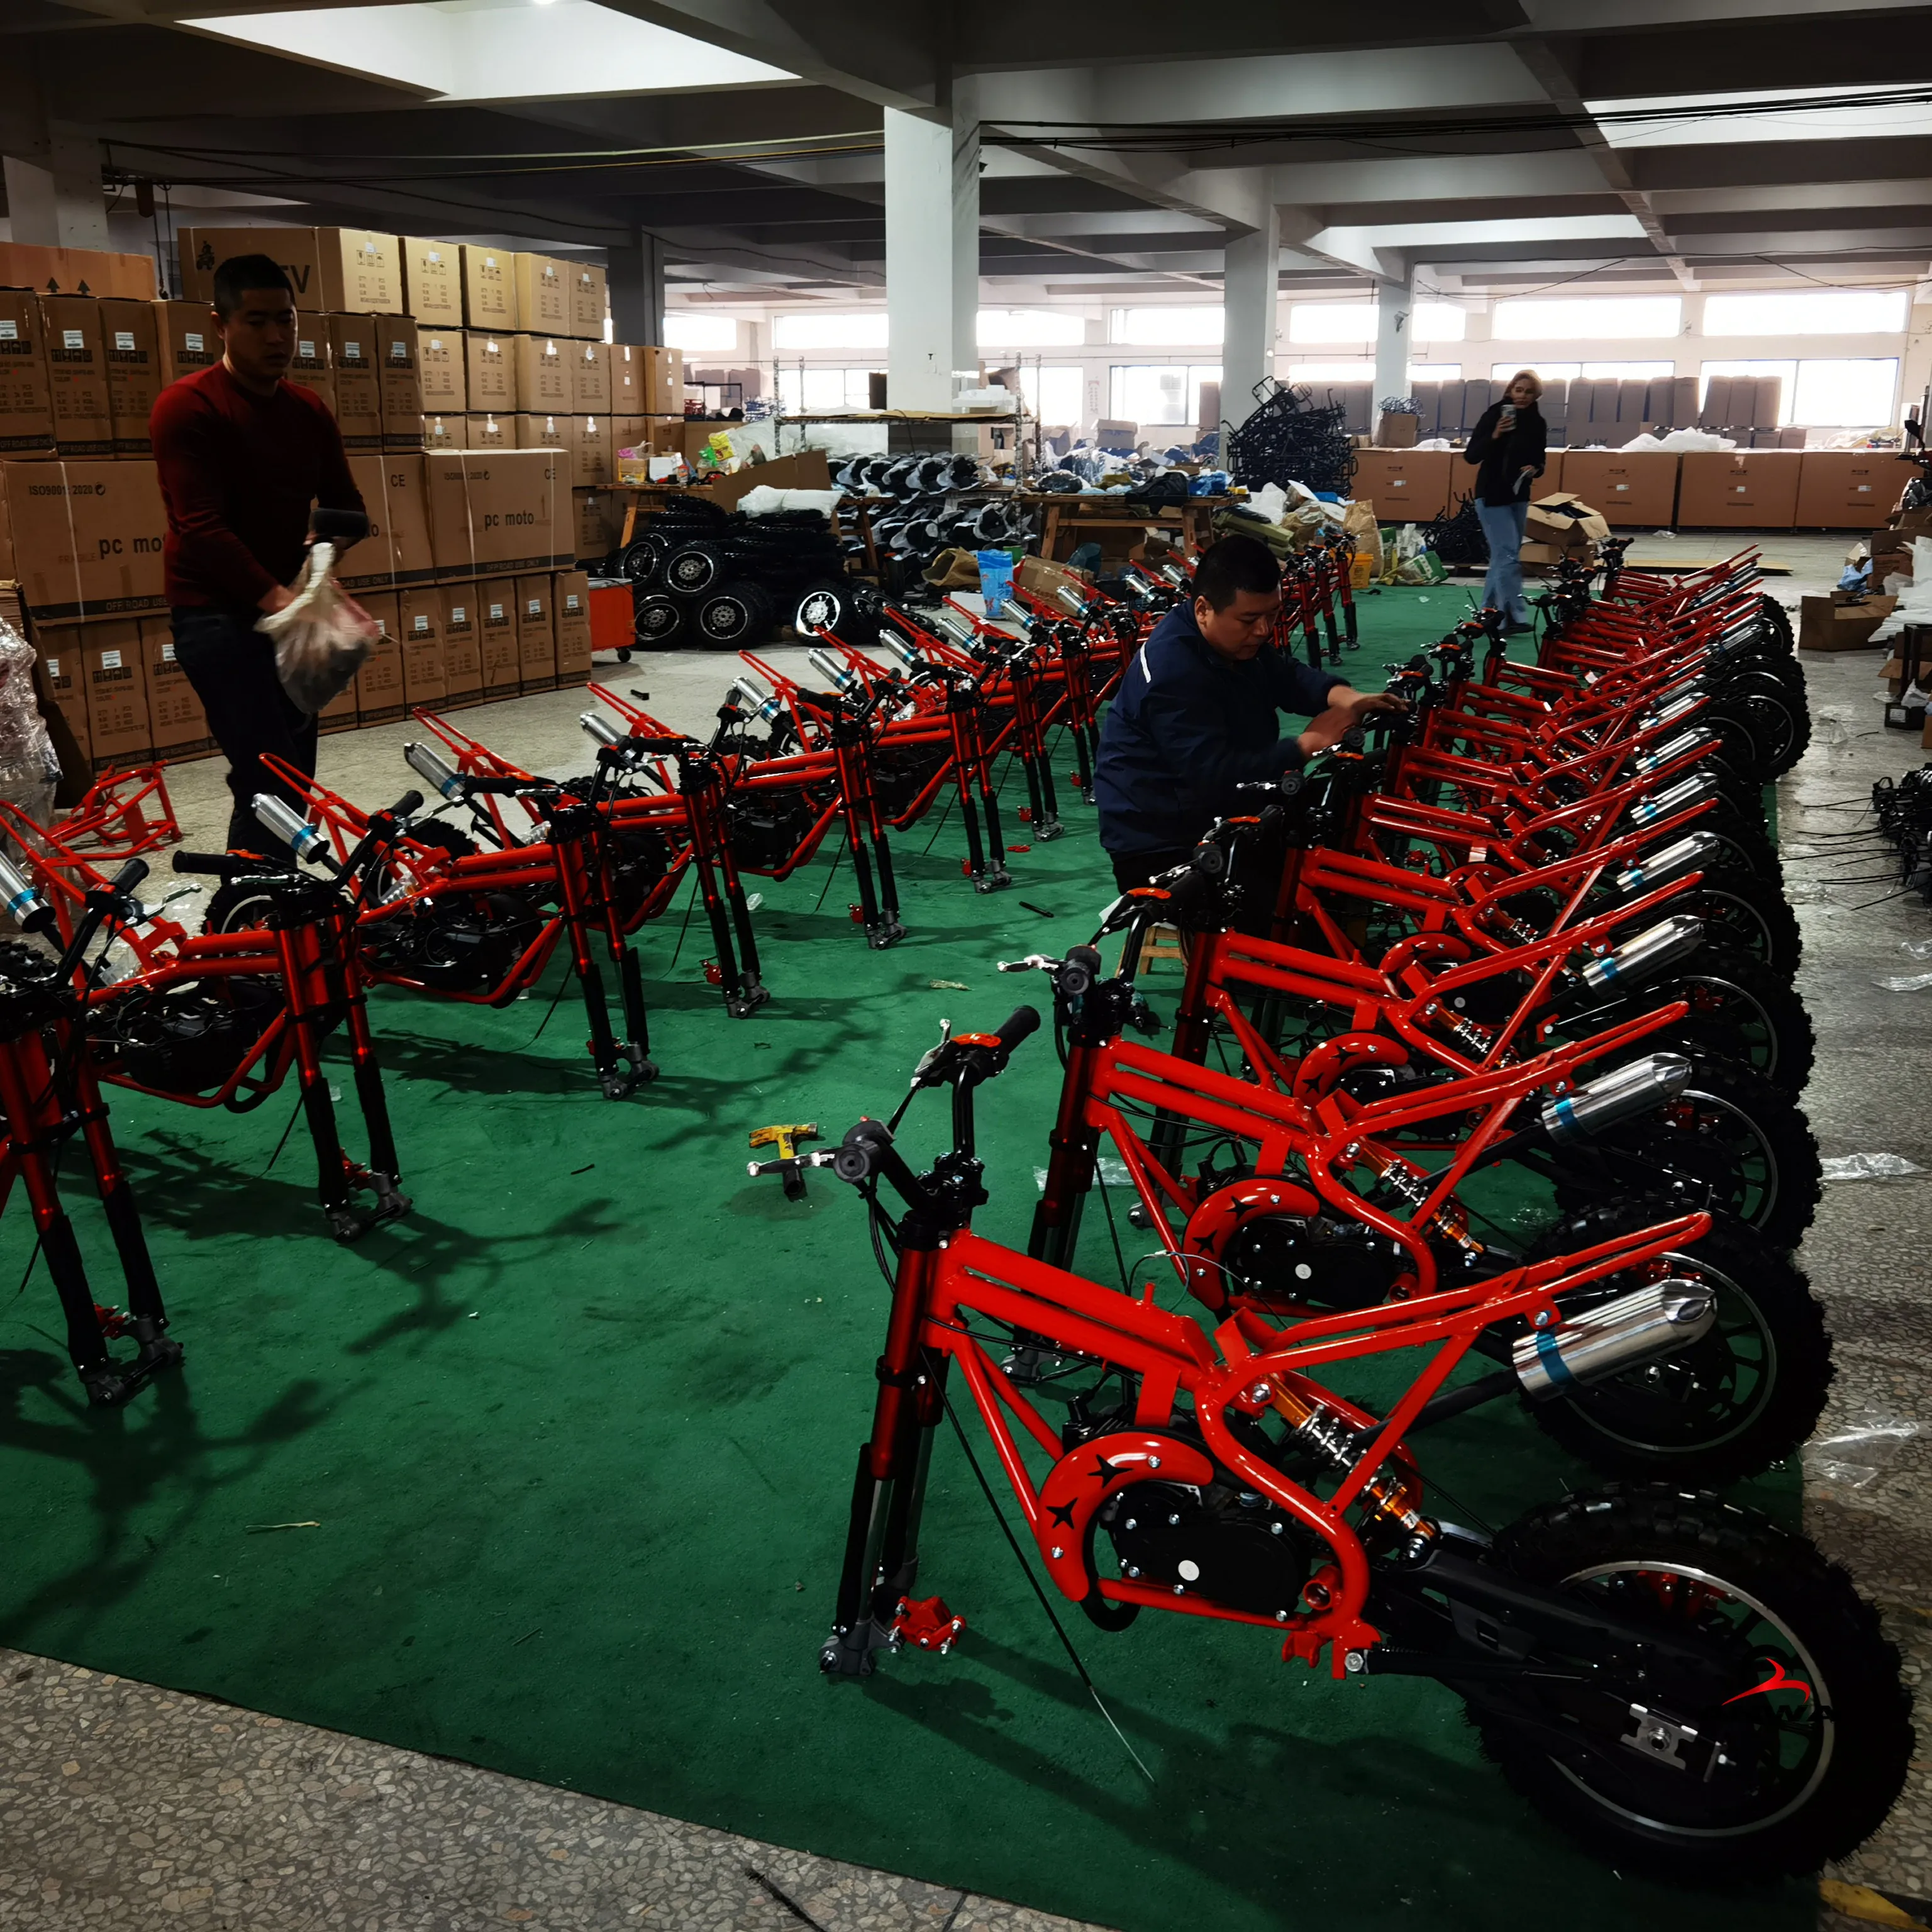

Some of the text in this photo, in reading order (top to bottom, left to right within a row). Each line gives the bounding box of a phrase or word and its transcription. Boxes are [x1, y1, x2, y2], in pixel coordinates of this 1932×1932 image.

[391, 474, 406, 487] CE
[484, 509, 535, 531] pc moto
[99, 533, 165, 560] pc mo
[106, 601, 123, 612] OFF
[125, 598, 150, 610] ROAD
